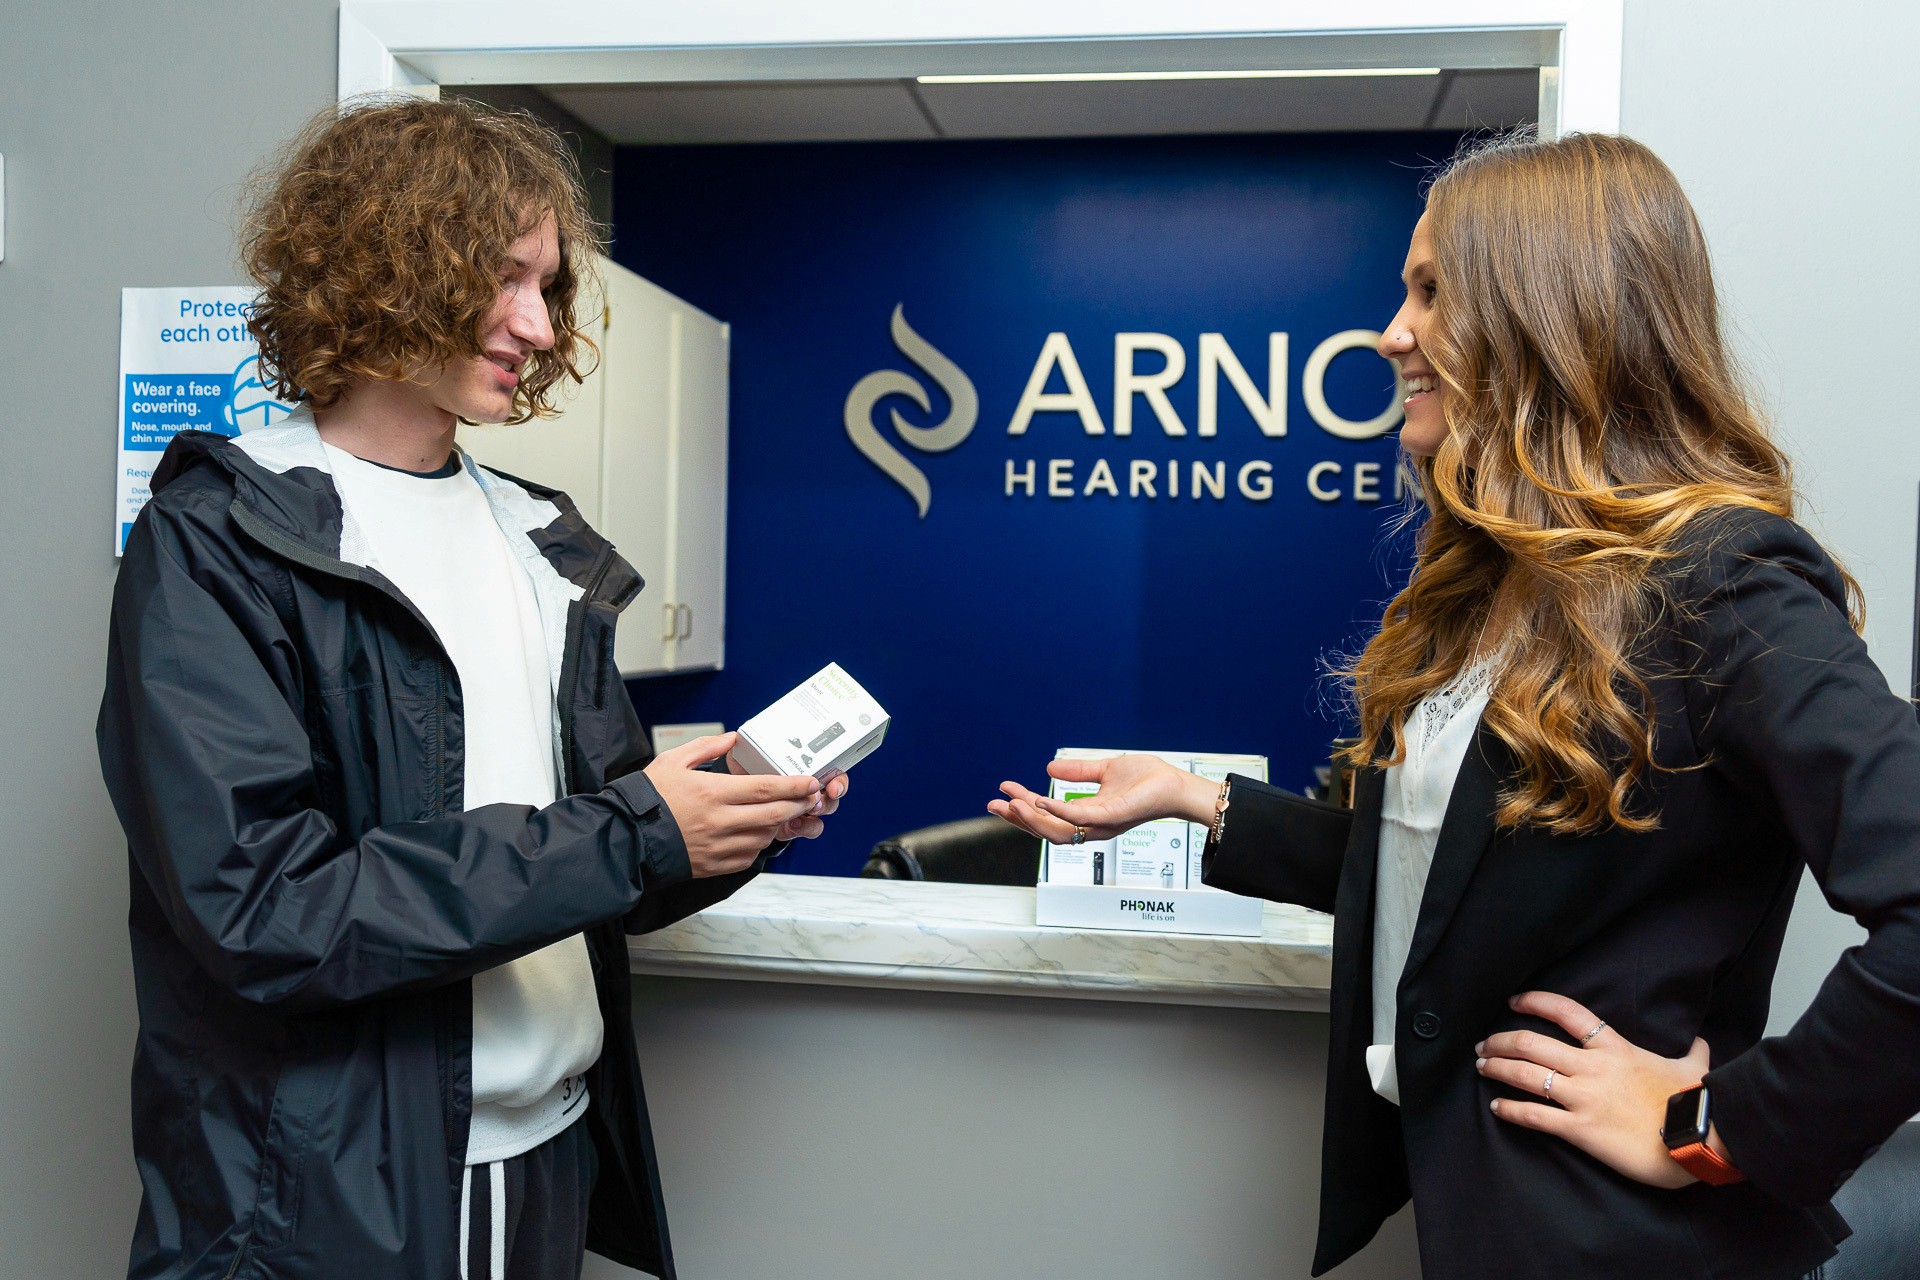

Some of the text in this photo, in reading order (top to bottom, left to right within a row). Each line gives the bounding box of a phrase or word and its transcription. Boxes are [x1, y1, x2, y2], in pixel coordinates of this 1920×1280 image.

[160, 323, 210, 343] each
[132, 381, 221, 396] Wear a face
[131, 398, 201, 417] covering.
[131, 422, 212, 432] Nose, mouth and
[131, 434, 152, 443] chin
[1004, 458, 1275, 500] HEARING
[1122, 828, 1158, 839] erenity
[1120, 899, 1175, 913] PHONAK
[1142, 912, 1155, 921] life
[1156, 913, 1163, 921] is
